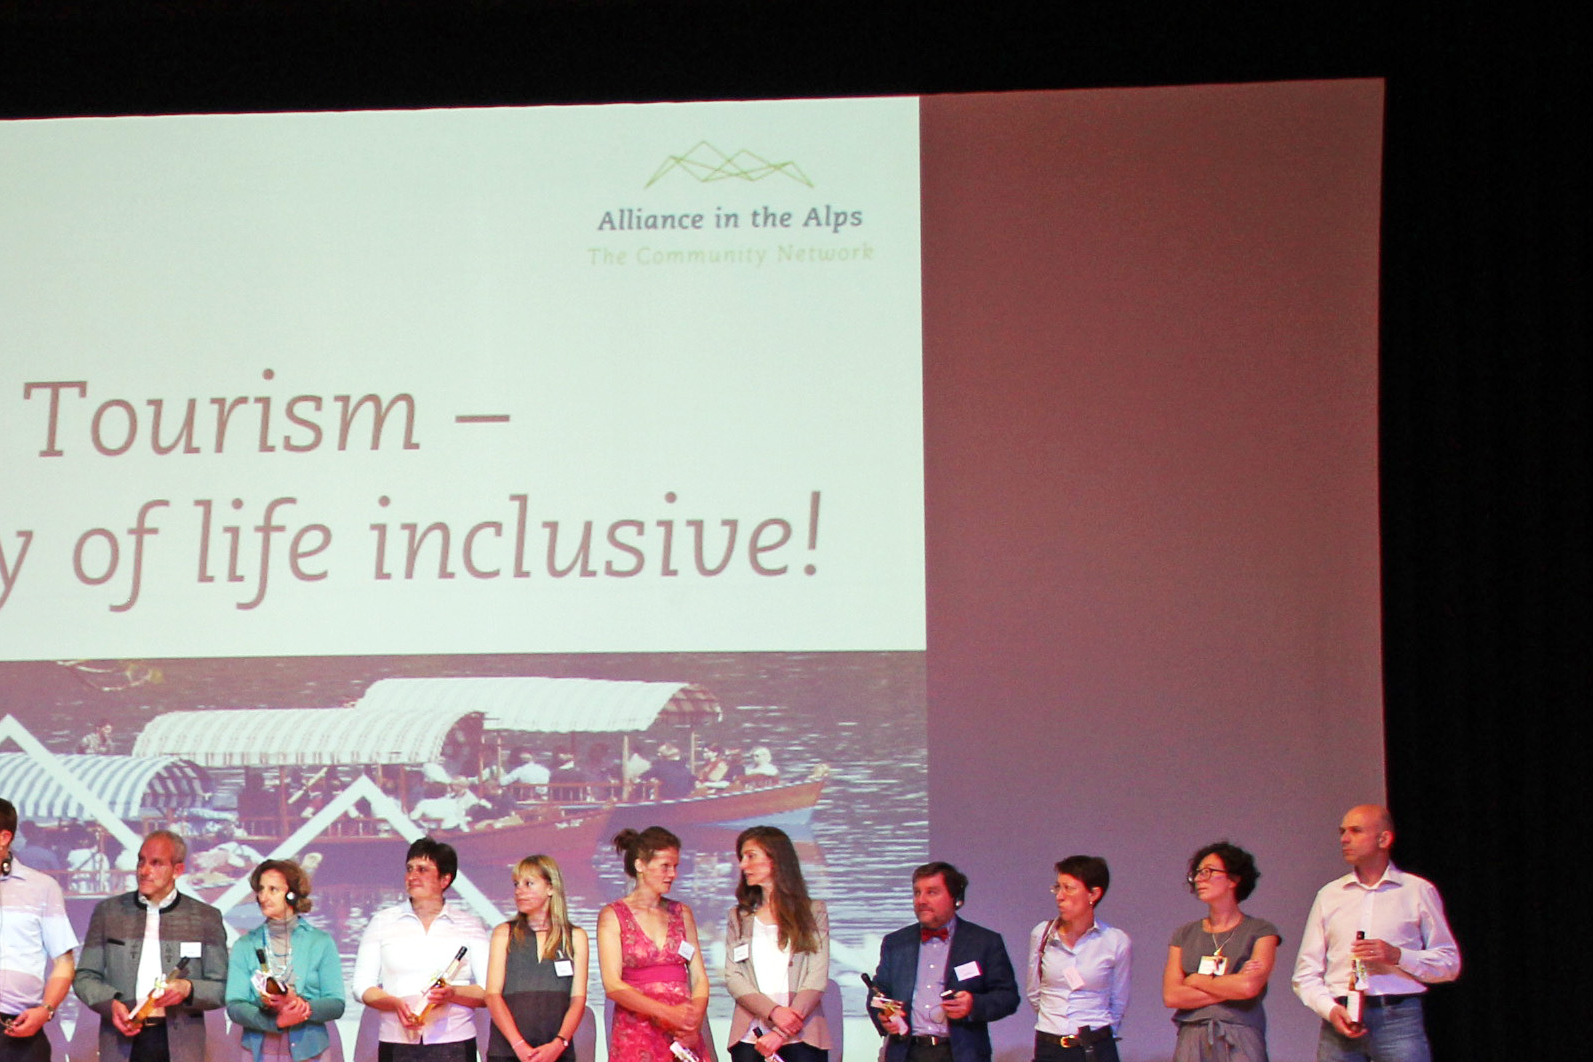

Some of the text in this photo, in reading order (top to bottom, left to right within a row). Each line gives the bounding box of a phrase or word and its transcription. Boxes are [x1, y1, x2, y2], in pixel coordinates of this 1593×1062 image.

[598, 205, 864, 234] Alliance in the Alps
[588, 242, 876, 268] The Community Network
[23, 368, 422, 458] Tourism
[71, 498, 172, 614] of
[193, 497, 333, 612] life
[369, 490, 823, 581] inclusive!
